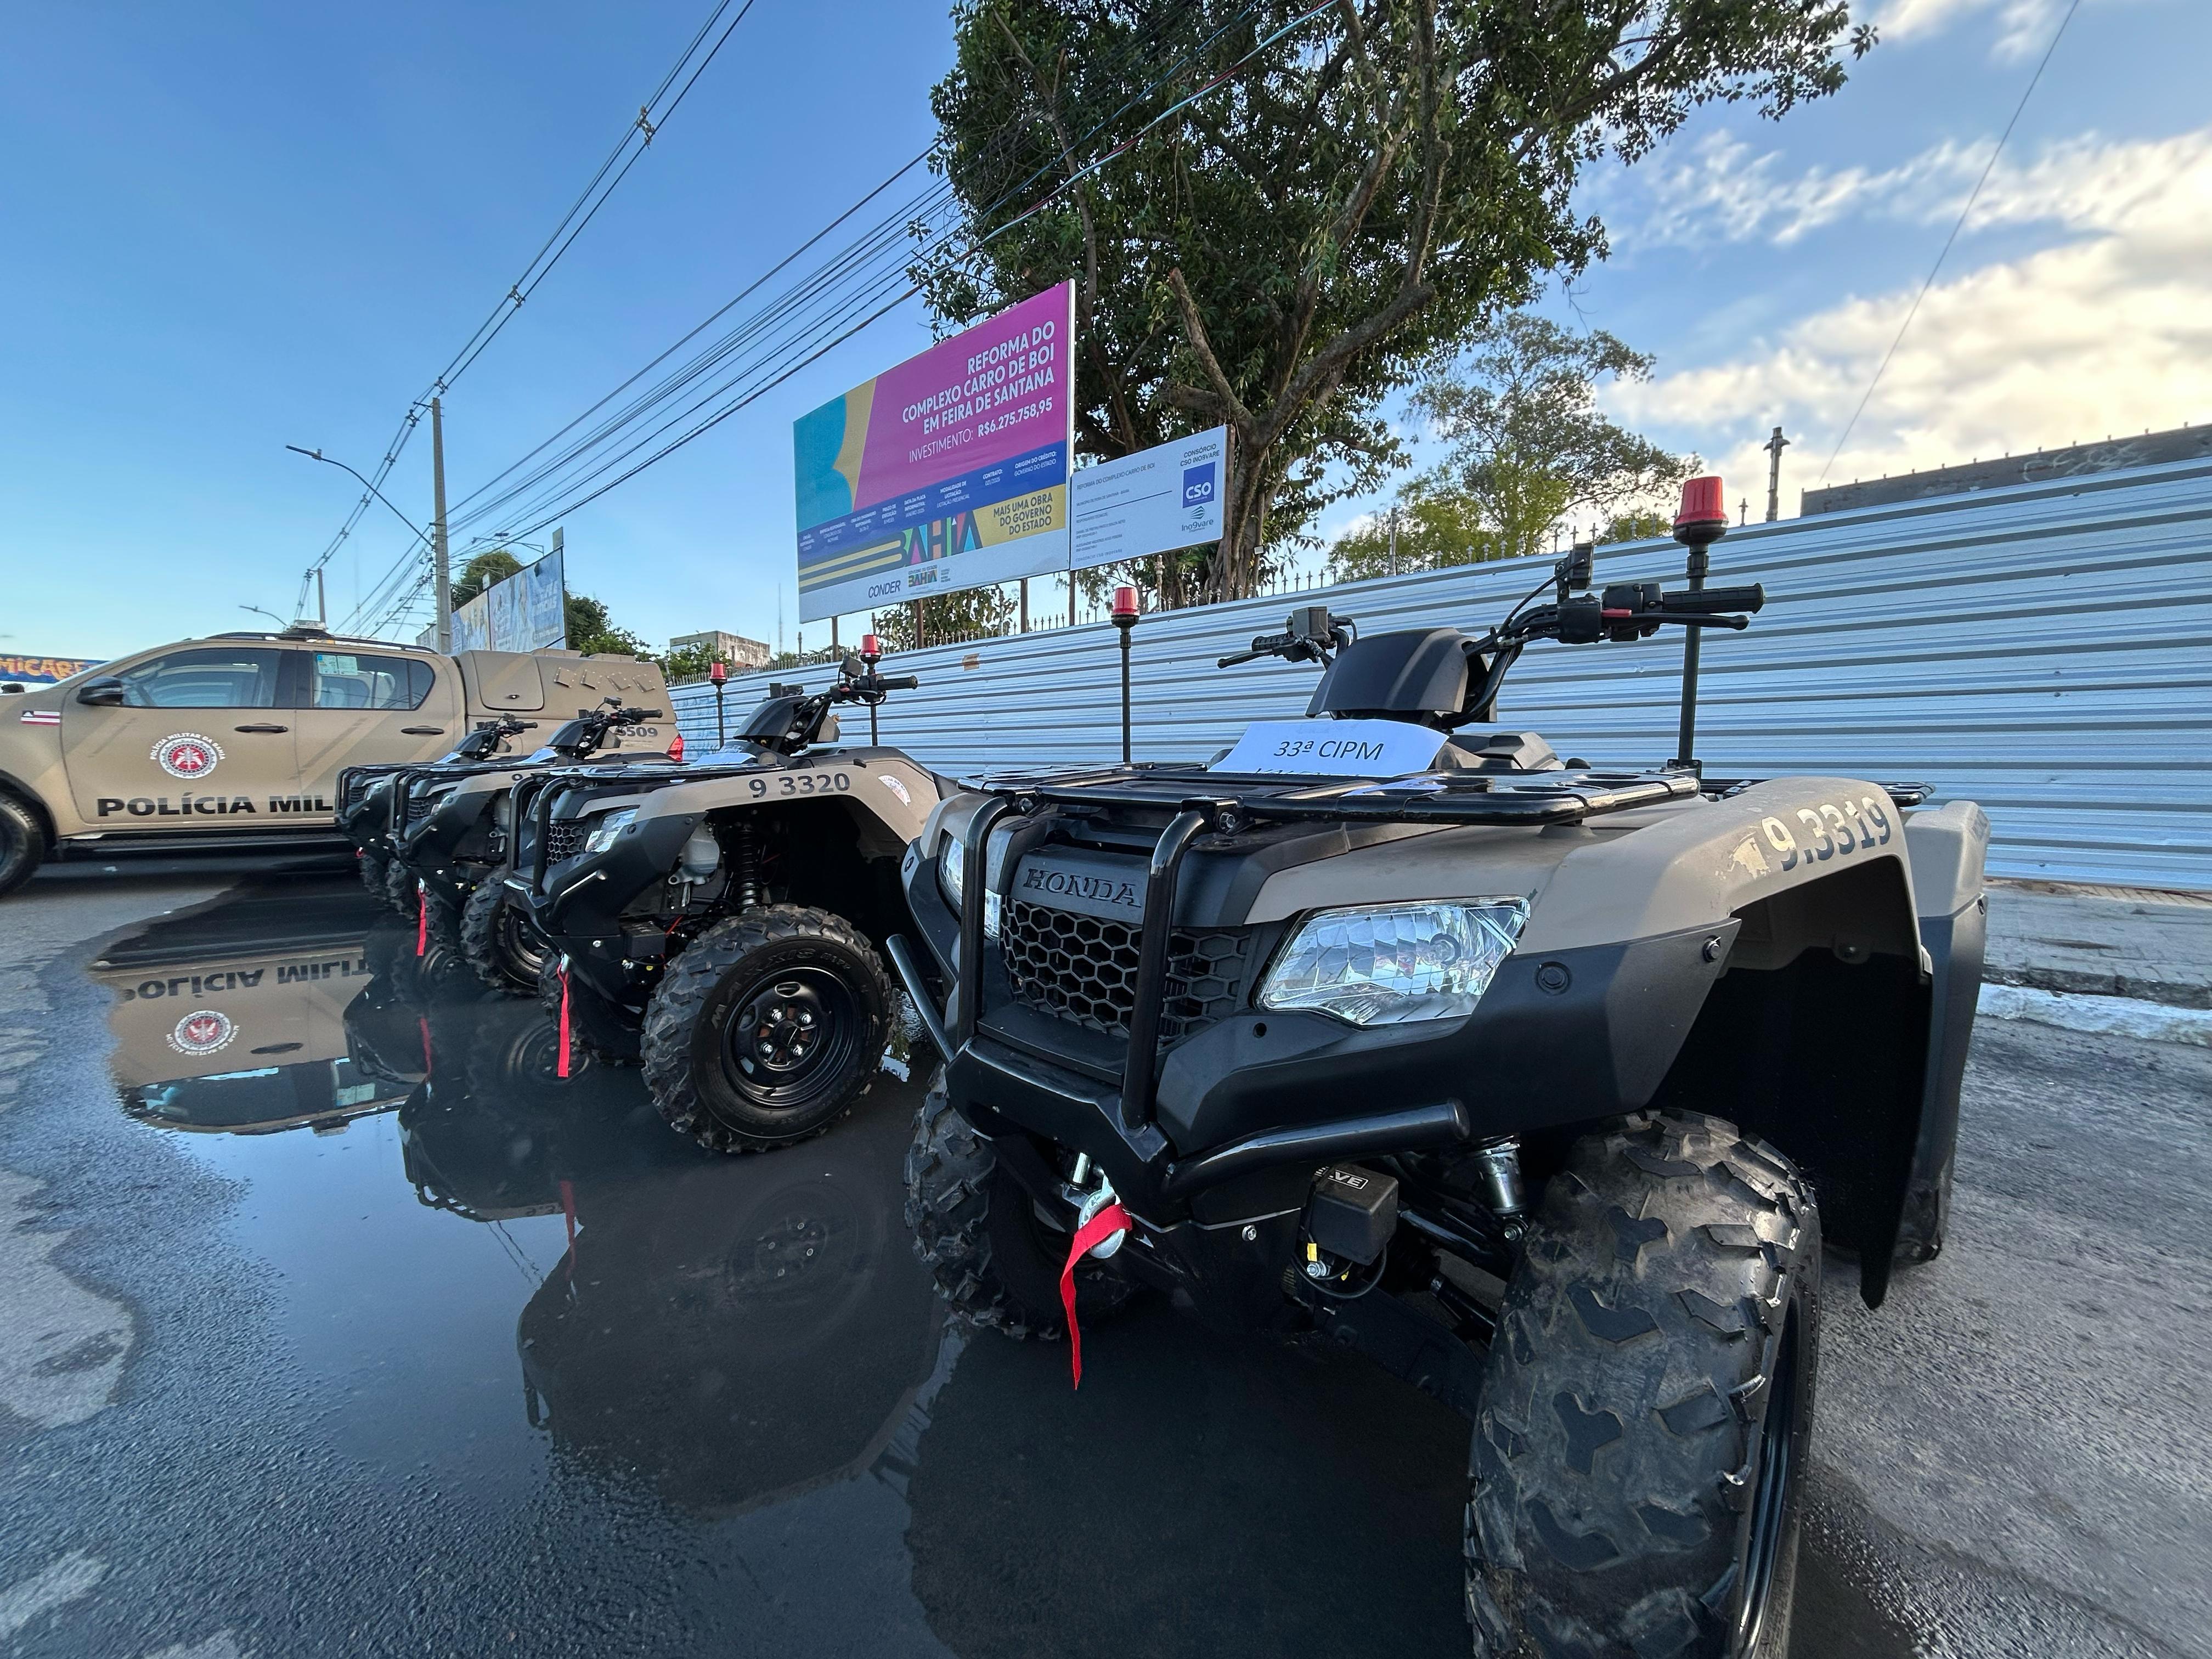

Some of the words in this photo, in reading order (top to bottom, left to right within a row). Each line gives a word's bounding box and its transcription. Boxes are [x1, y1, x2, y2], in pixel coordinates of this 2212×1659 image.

[968, 332, 1029, 375] REFORMA
[1032, 320, 1054, 346] DO
[902, 385, 961, 423] COMPLEXO
[963, 365, 1005, 397] CARRO
[1009, 355, 1025, 379] DE
[1029, 343, 1054, 370] BOI
[924, 415, 939, 435] EM
[942, 400, 973, 427] FEIRA
[976, 392, 991, 414] DE
[994, 366, 1054, 407] SANTANA
[909, 428, 974, 464] INVESTIMENTO:
[978, 397, 1053, 437] R$6.275.758,95
[1181, 458, 1192, 466] CSO
[1184, 443, 1216, 458] CONSÓRCIO
[1186, 482, 1212, 500] CSO
[994, 506, 1010, 518] MAIS
[1012, 499, 1029, 512] UMA
[1031, 493, 1053, 505] OBRA
[1000, 516, 1012, 527] DO
[1013, 504, 1052, 523] GOVERNO
[1009, 525, 1020, 535] DO
[1022, 516, 1052, 532] ESTADO
[1182, 519, 1214, 532] Ino9vare
[868, 580, 901, 599] CONDER
[909, 569, 937, 587] BAHIA
[1273, 741, 1314, 757] 33ª
[1318, 741, 1385, 761] CIPM
[749, 779, 766, 798] 9
[778, 773, 850, 795] 3320
[97, 792, 256, 816] POLÍCIA
[1761, 797, 1891, 871] 9.3319
[1023, 868, 1142, 908] HONDA
